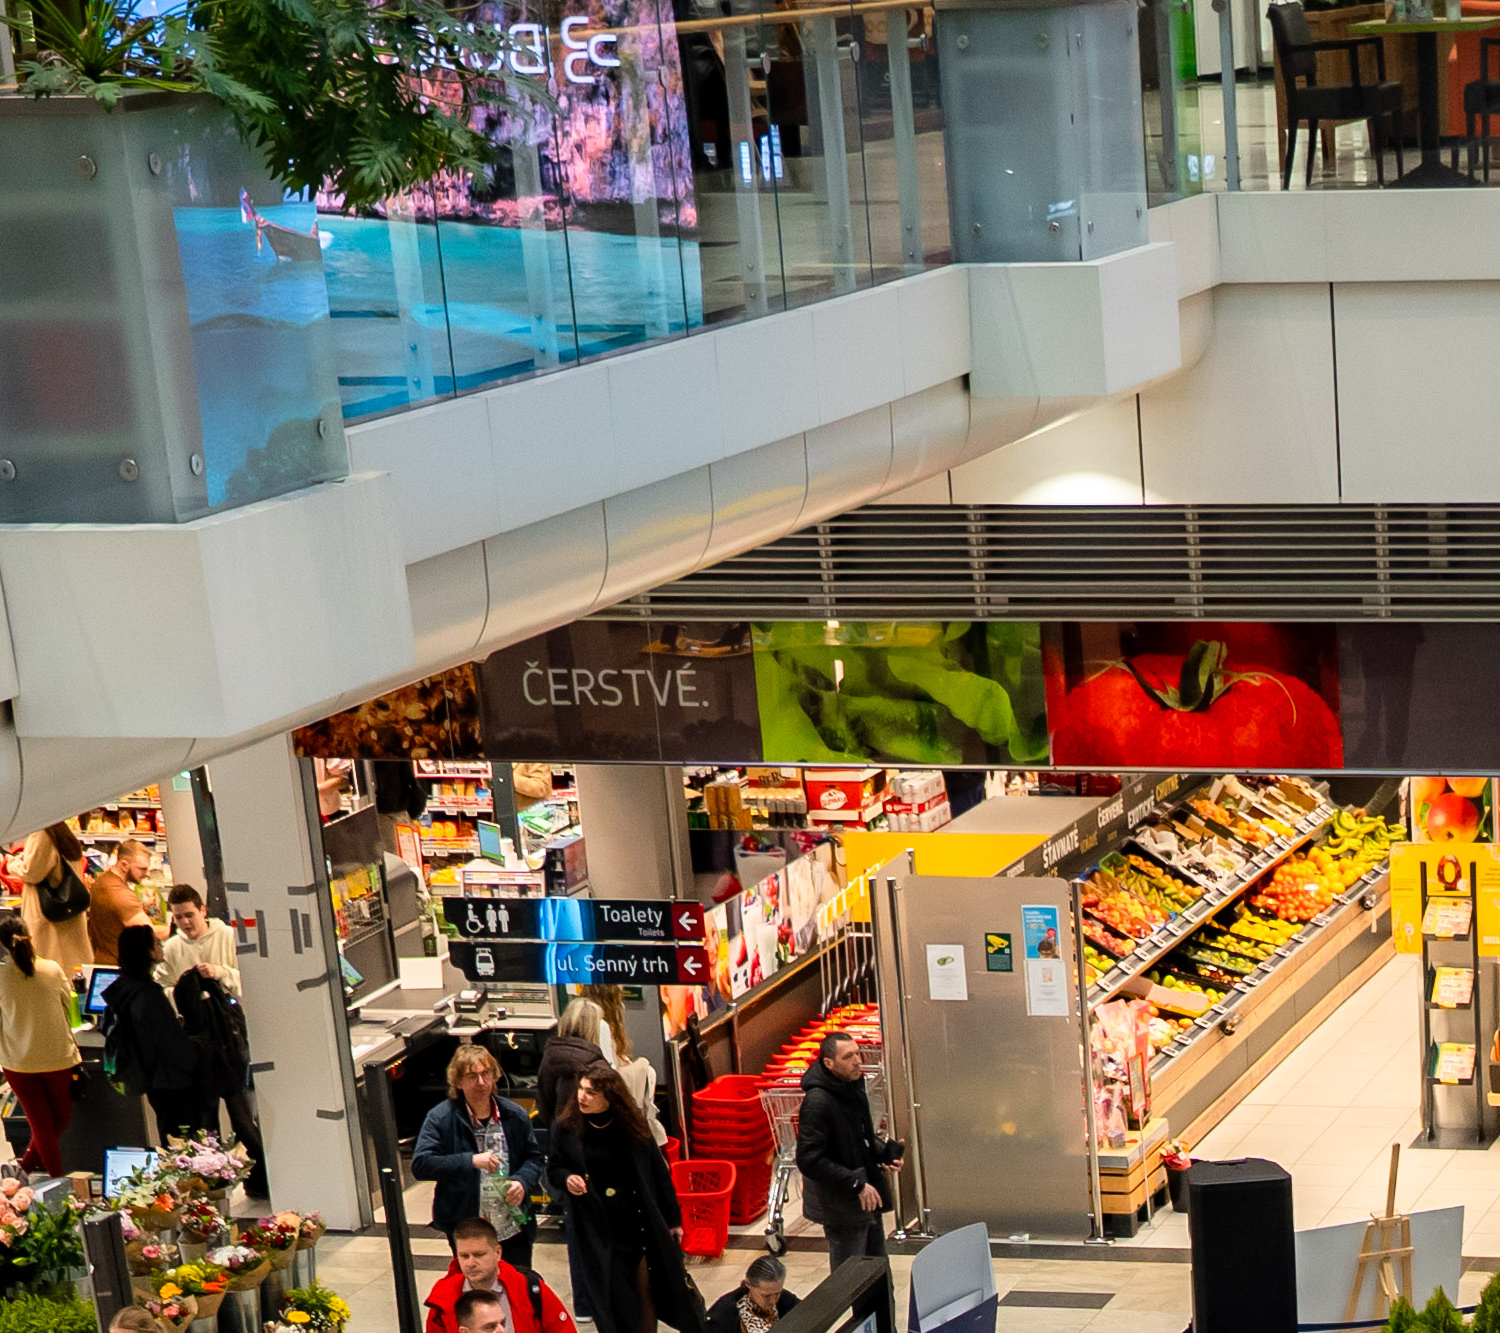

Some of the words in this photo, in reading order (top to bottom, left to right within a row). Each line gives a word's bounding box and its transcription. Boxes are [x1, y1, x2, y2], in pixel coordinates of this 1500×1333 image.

[522, 659, 710, 710] ČERSTVÉ.
[600, 905, 663, 927] Toalety
[638, 927, 665, 937] Toilets
[556, 957, 580, 972] ul.
[583, 955, 638, 976] Senný
[643, 957, 669, 973] trh
